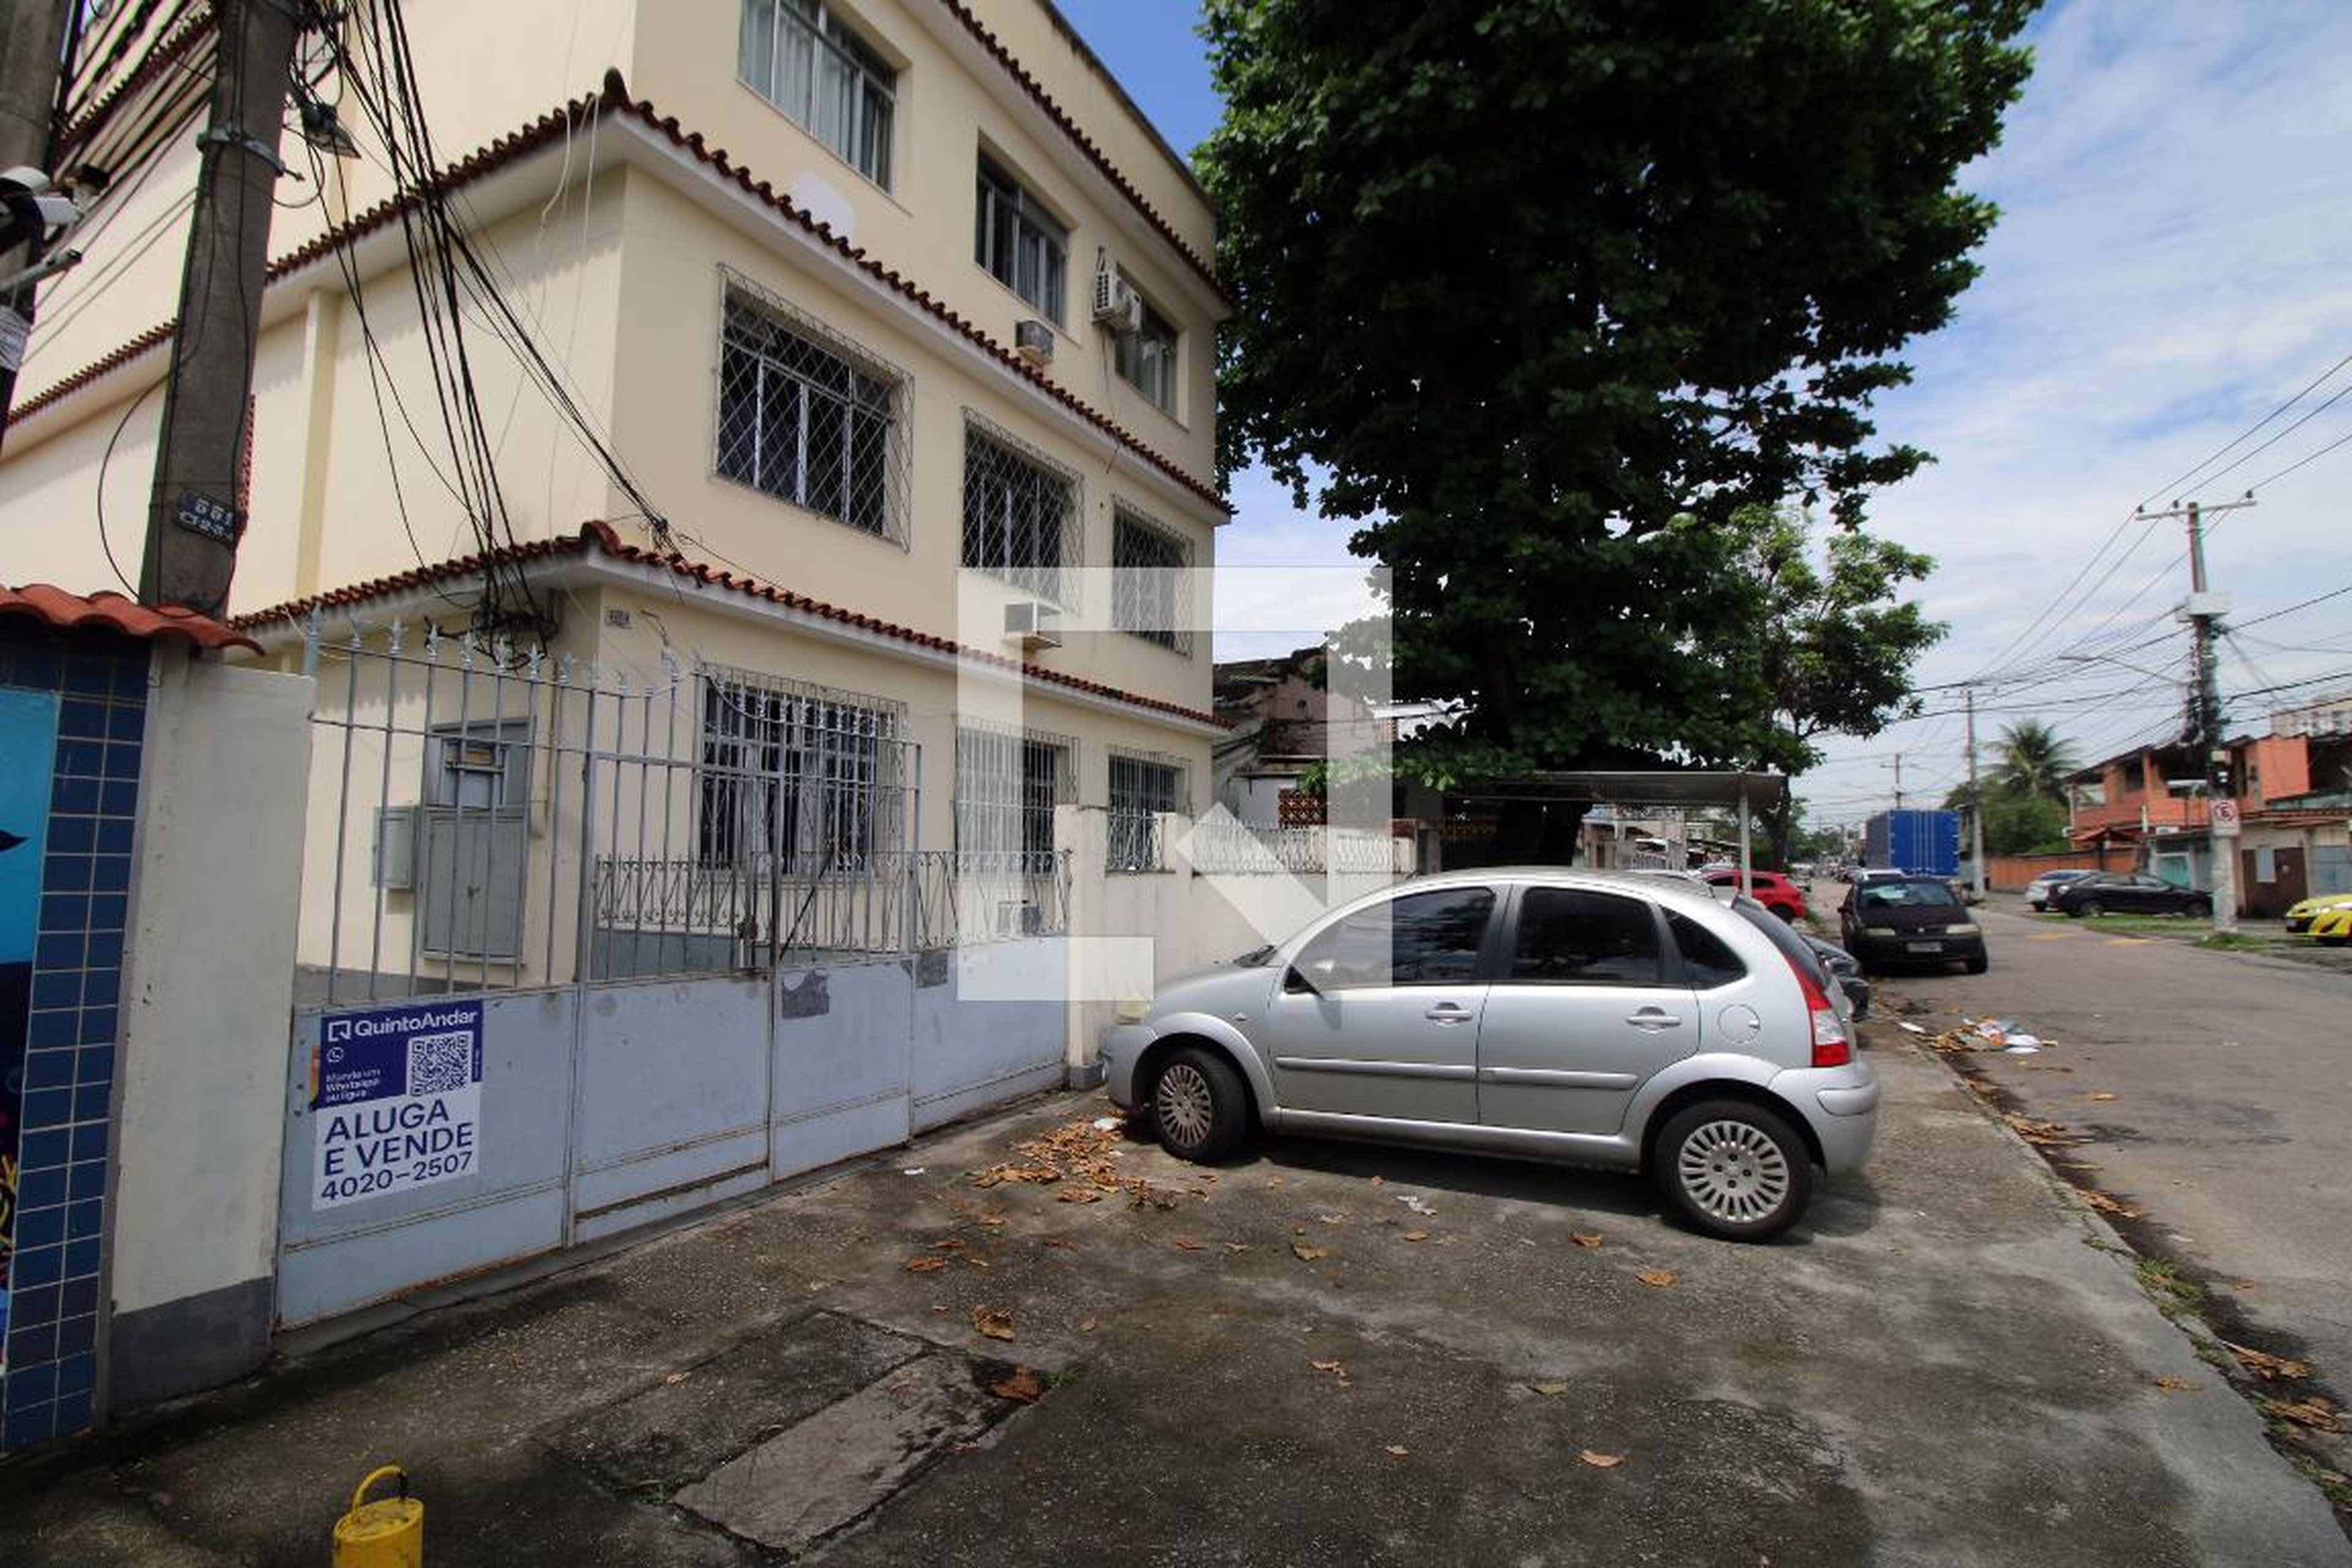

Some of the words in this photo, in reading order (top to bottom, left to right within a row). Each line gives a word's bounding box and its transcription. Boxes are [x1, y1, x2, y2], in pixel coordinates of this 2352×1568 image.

[354, 1010, 478, 1036] QuintoAndar
[325, 1099, 450, 1144] ALUGA
[325, 1147, 345, 1176] E
[356, 1122, 474, 1167] VENDE
[322, 1152, 473, 1200] 4020-2507
